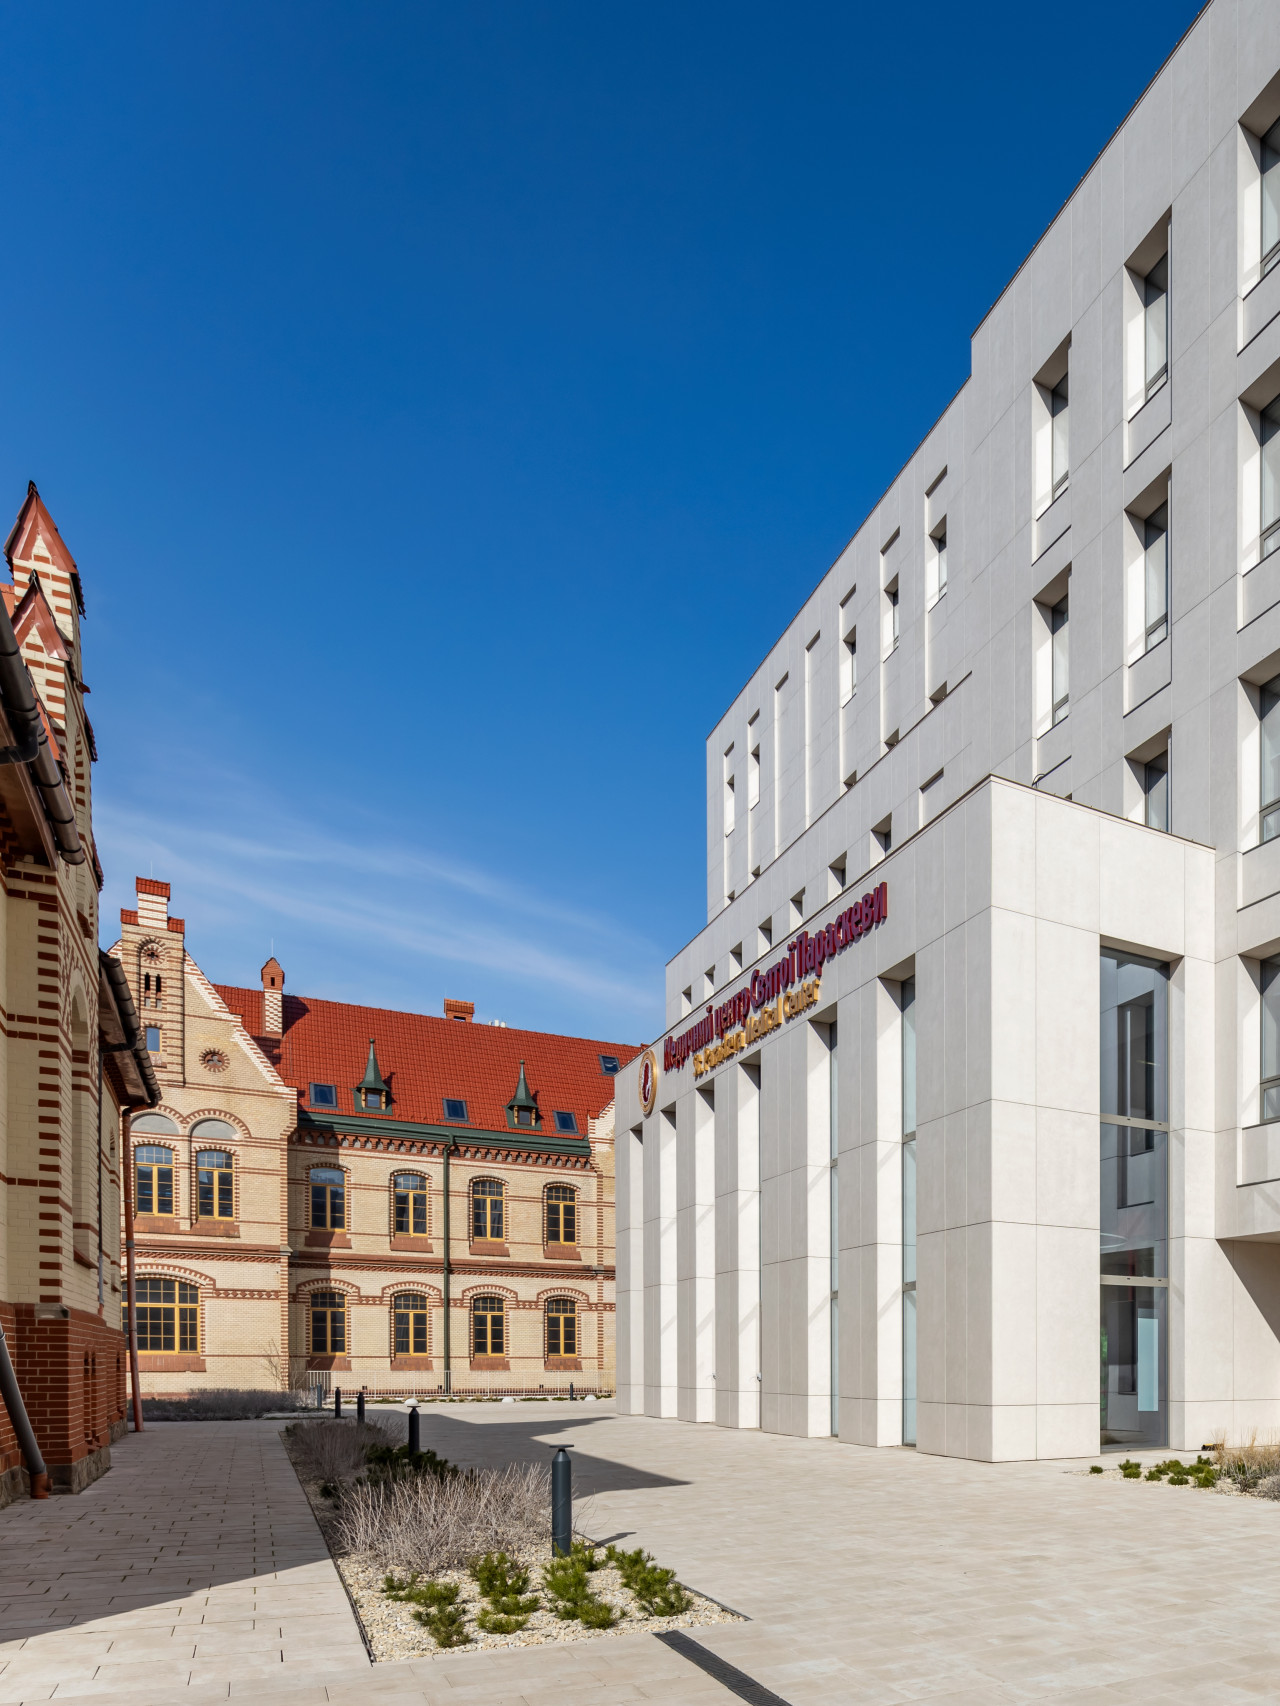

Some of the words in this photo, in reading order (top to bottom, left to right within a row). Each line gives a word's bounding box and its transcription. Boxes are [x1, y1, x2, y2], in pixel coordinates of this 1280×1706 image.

[714, 987, 750, 1039] центр
[750, 941, 795, 1008] Святої
[796, 882, 887, 976] Параскеви
[745, 996, 782, 1044] Medical
[783, 978, 820, 1018] Center
